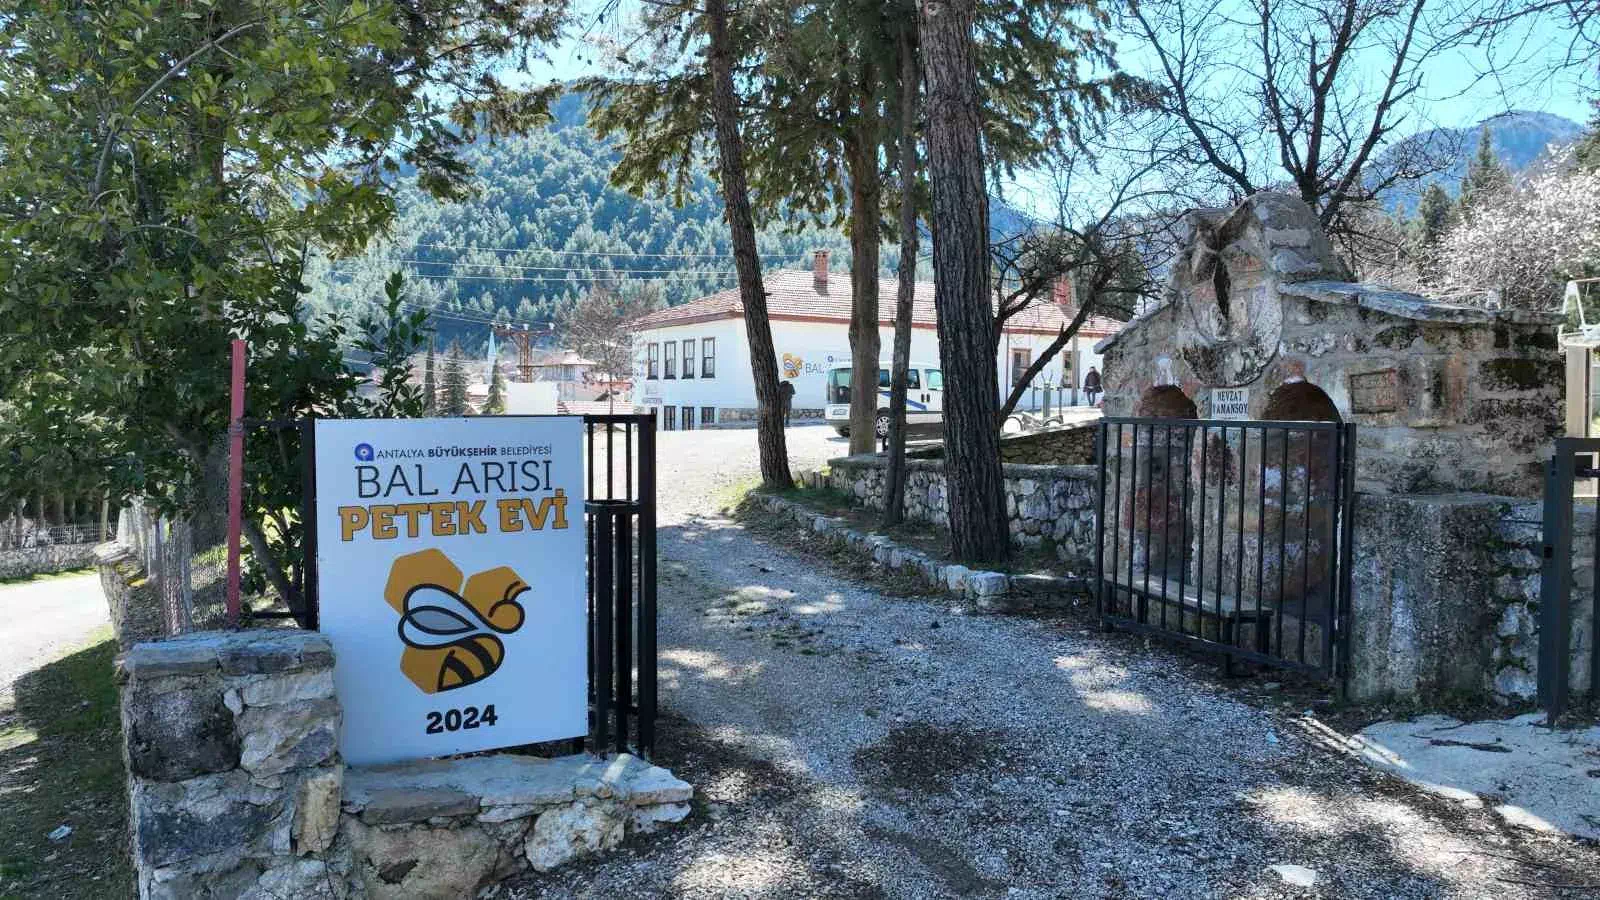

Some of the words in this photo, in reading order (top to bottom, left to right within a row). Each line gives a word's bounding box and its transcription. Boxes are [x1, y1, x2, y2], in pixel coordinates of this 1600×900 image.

[377, 448, 424, 459] ANTALYA
[427, 445, 497, 458] BÜYÜKŞEHİR
[501, 443, 552, 456] BELEDİYESİ
[354, 464, 438, 498] BAL
[451, 460, 552, 494] ARISI
[338, 500, 487, 541] PETEK
[497, 488, 568, 532] EVİ
[426, 704, 498, 734] 2024
